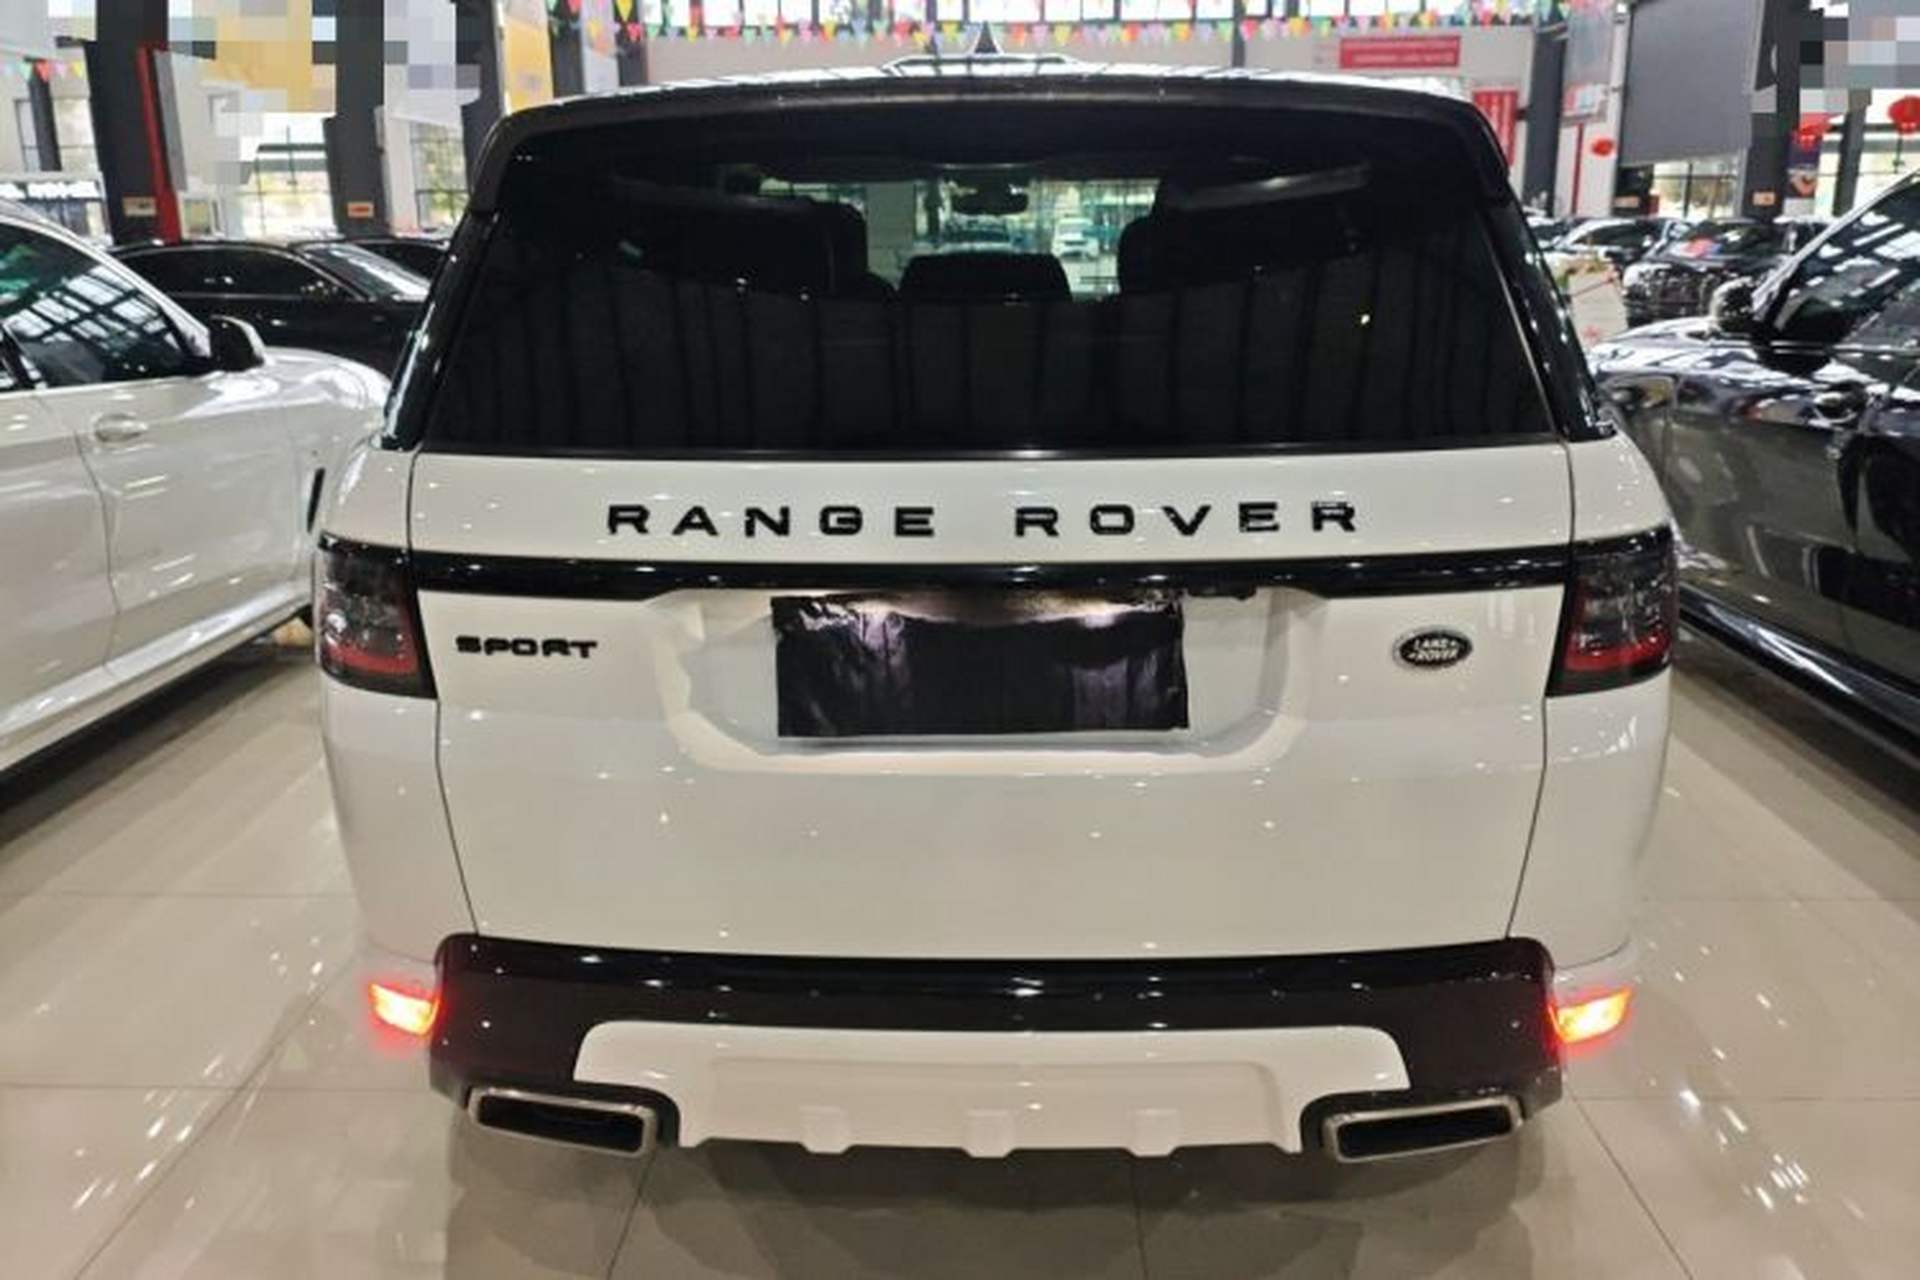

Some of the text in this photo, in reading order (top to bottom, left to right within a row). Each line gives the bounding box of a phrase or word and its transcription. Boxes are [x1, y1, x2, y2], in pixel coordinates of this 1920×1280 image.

[607, 500, 1358, 537] RANGE ROVER
[455, 635, 598, 659] SPORT
